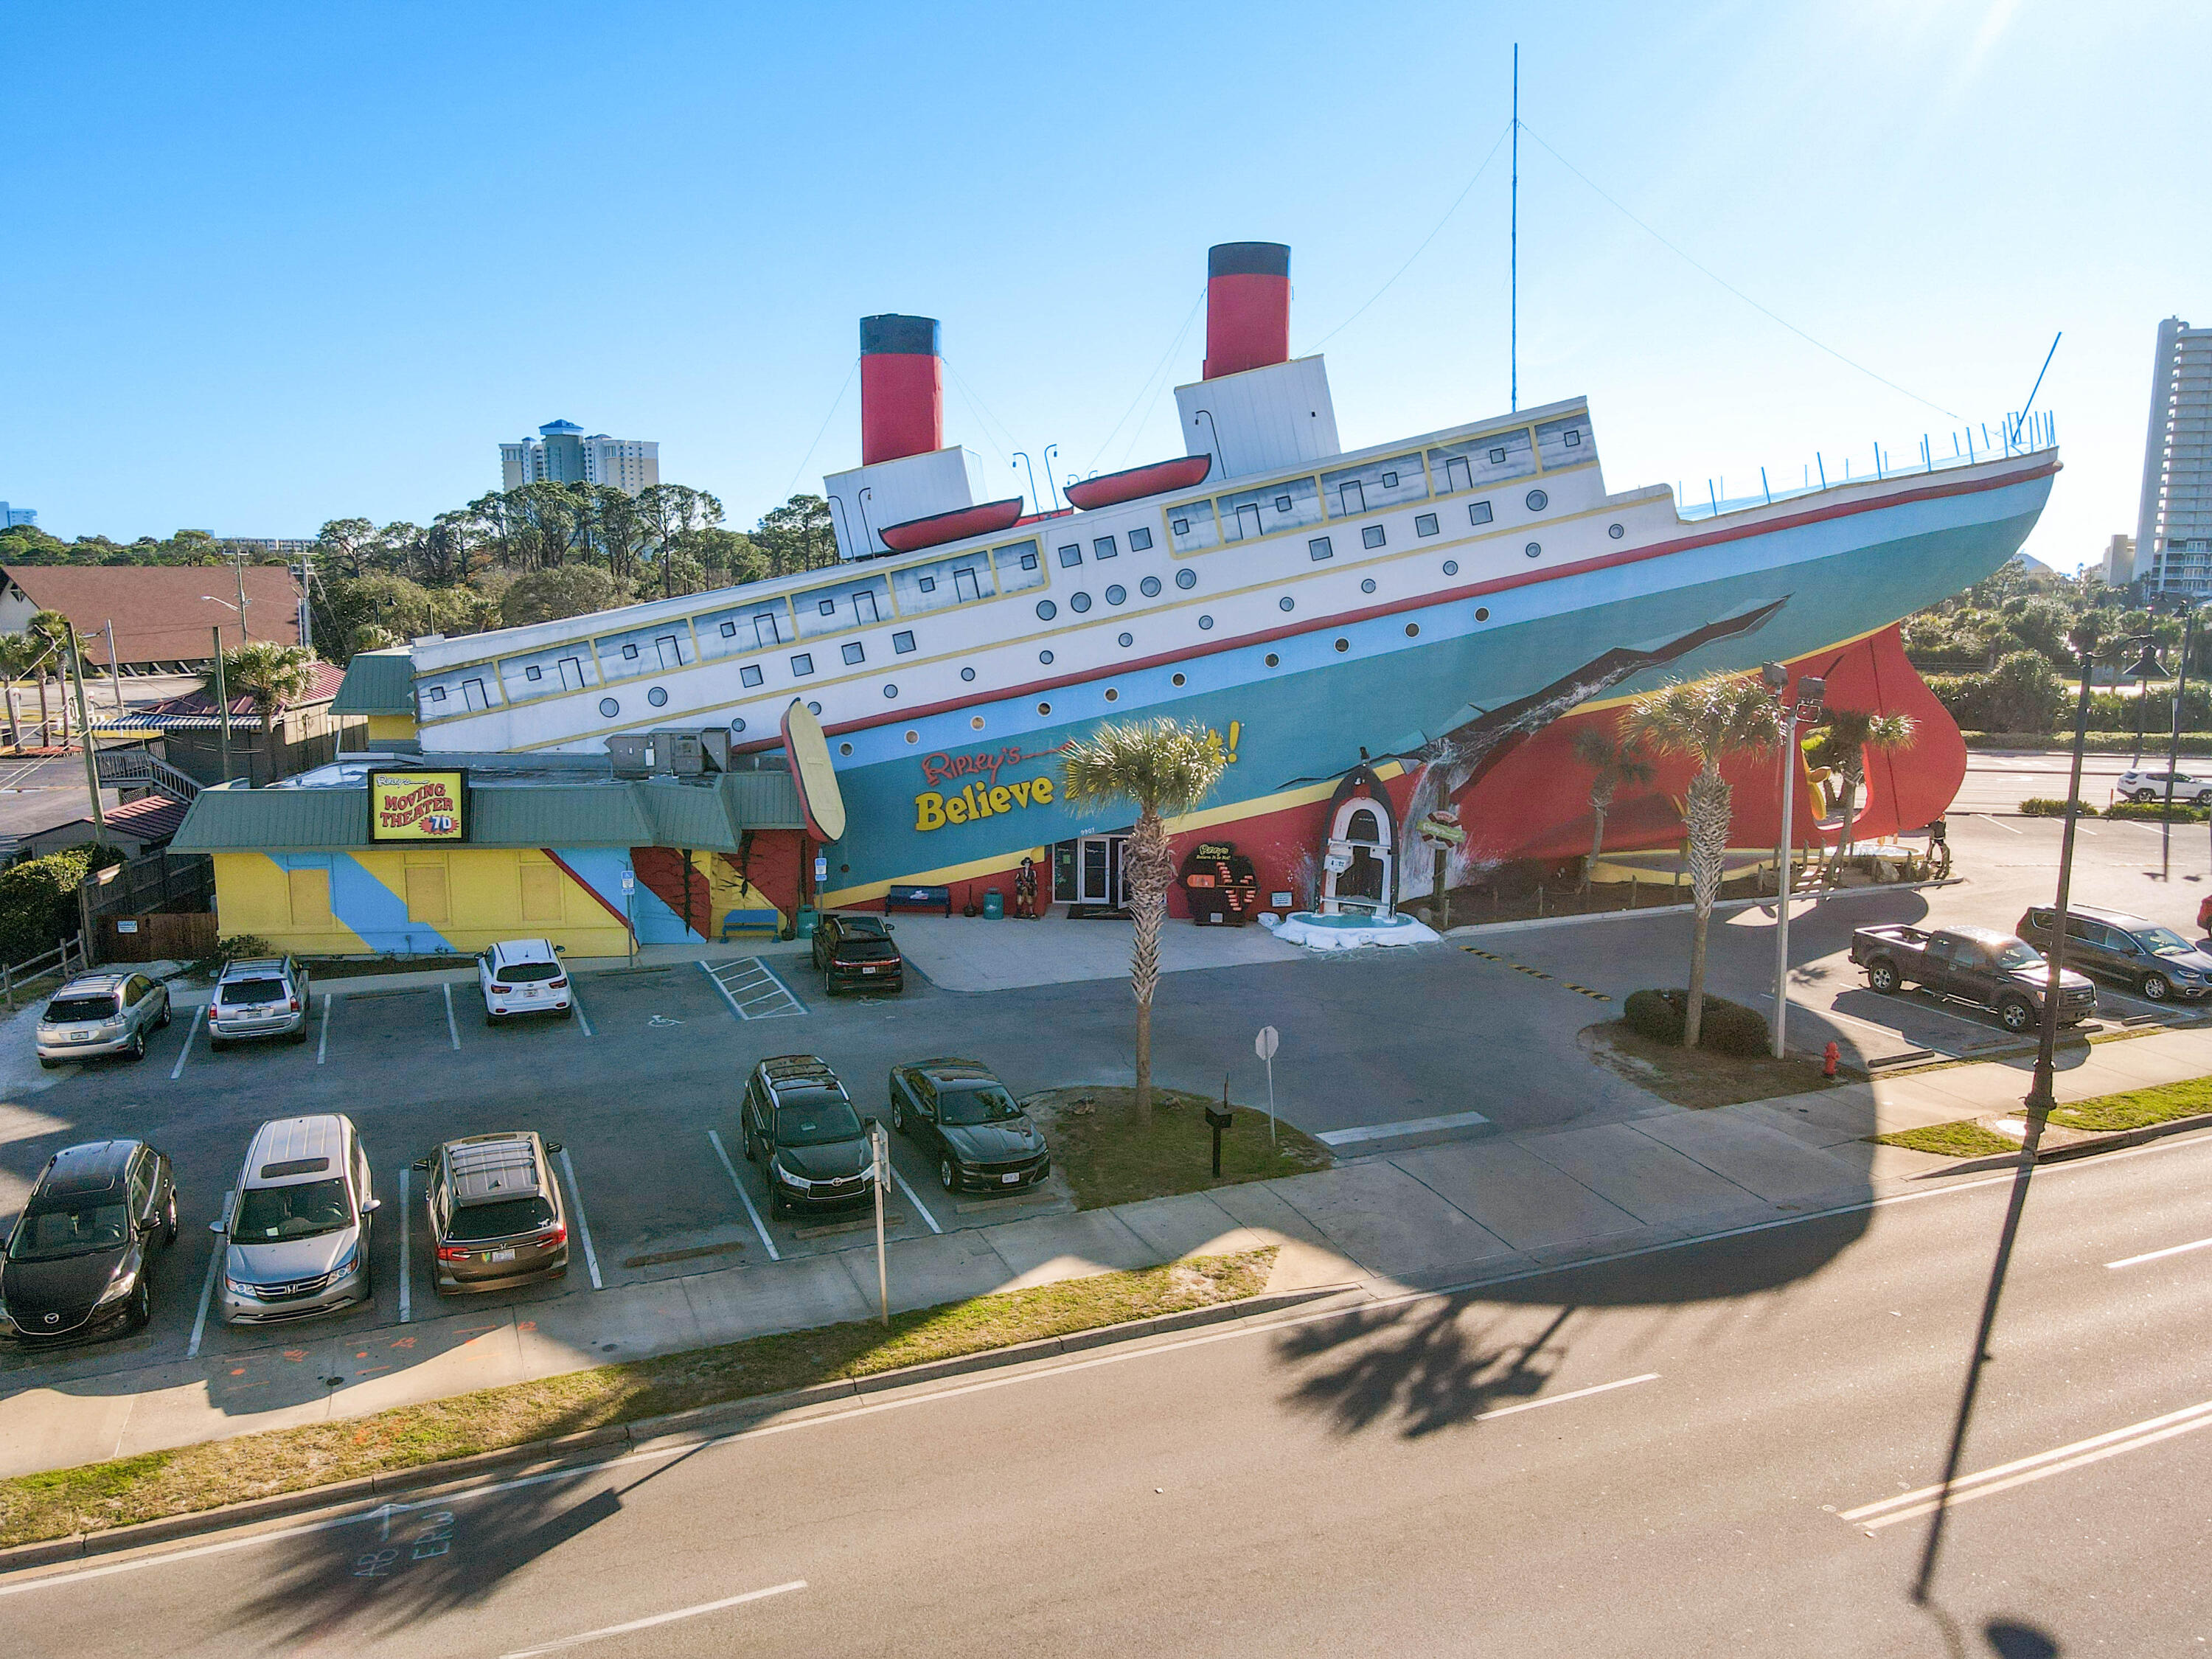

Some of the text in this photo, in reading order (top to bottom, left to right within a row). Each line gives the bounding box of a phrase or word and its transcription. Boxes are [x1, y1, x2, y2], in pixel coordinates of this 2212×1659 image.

[384, 782, 446, 811] MOVING
[914, 776, 1054, 832] Believe
[380, 797, 453, 827] THEATER
[430, 815, 452, 832] 7D
